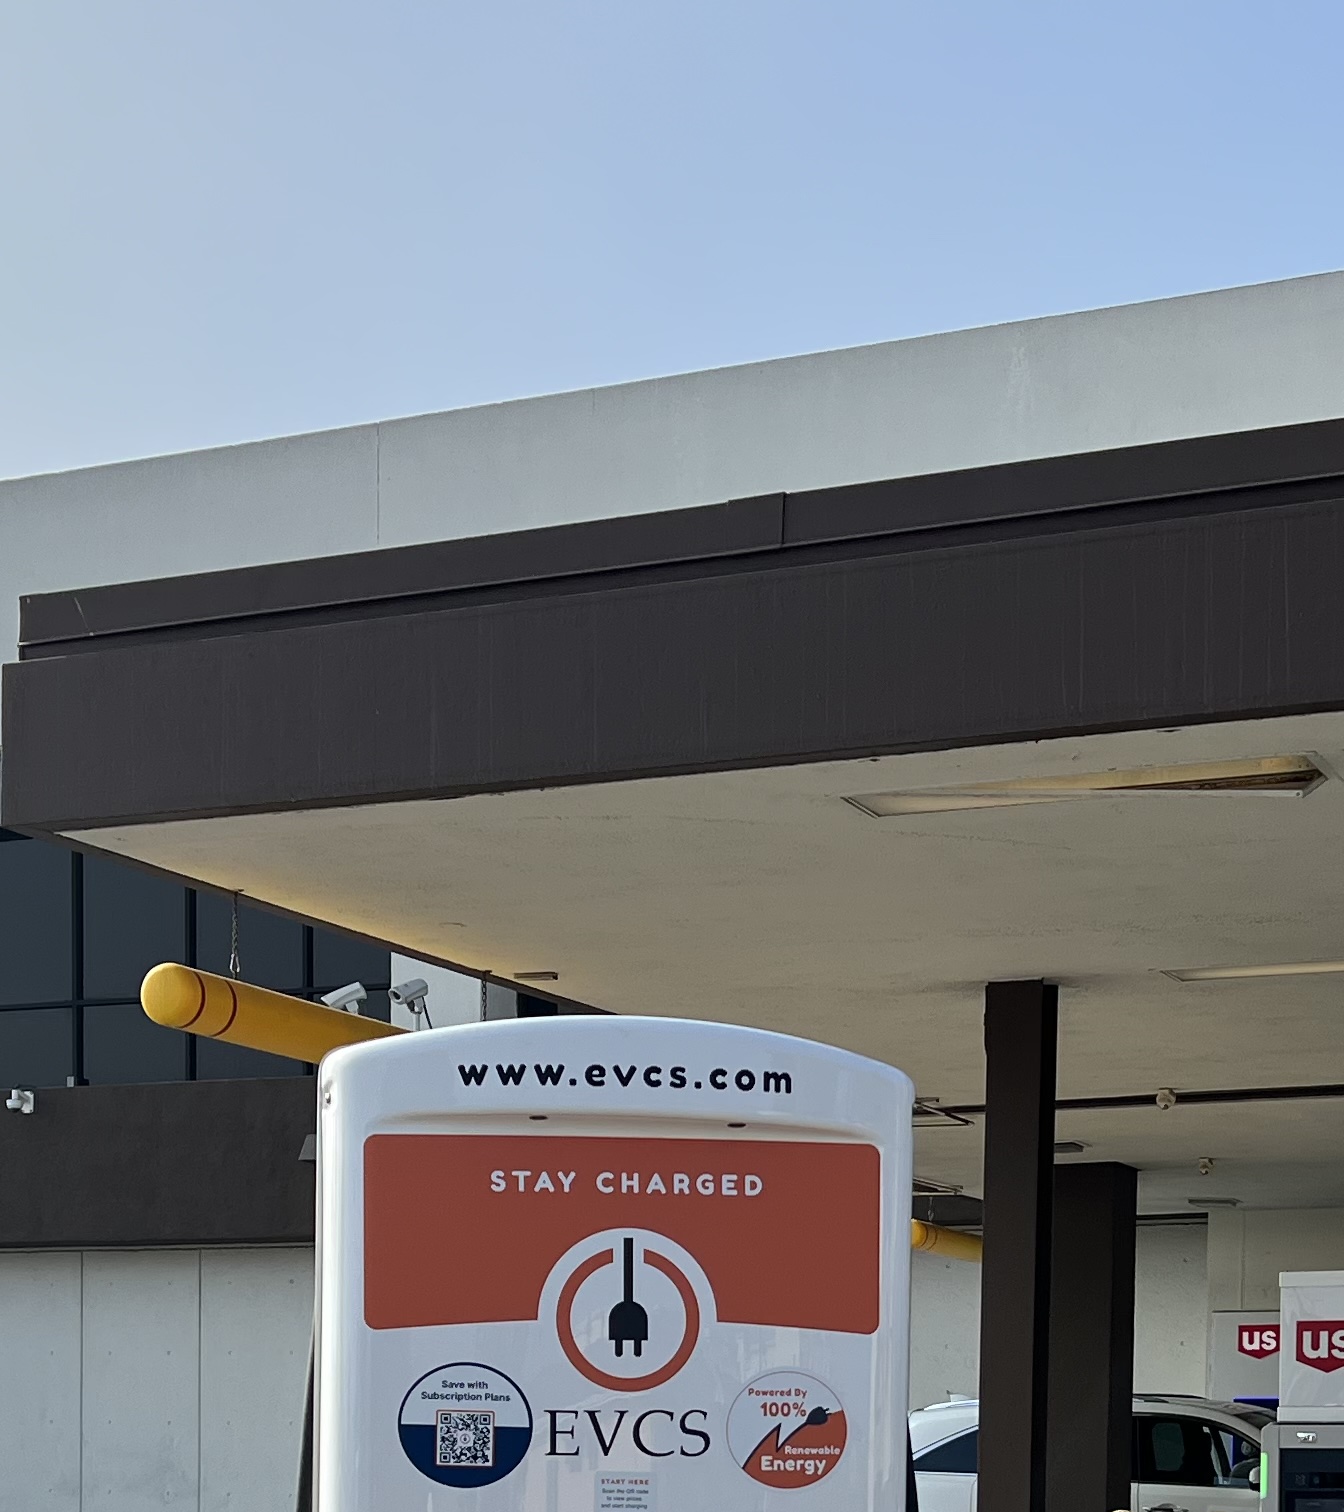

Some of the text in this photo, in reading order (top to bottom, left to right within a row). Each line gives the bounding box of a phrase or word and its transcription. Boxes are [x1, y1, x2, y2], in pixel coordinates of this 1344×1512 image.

[457, 1063, 793, 1094] www.evcs.com
[490, 1170, 763, 1197] STAY CHARGED
[1242, 1331, 1277, 1351] us
[441, 1380, 489, 1390] Save with
[748, 1388, 807, 1399] Powered By
[421, 1391, 511, 1402] Subscription Plans
[760, 1401, 807, 1417] 100%
[543, 1409, 711, 1457] EVCS
[784, 1445, 841, 1455] Renewable
[760, 1455, 826, 1475] Energy
